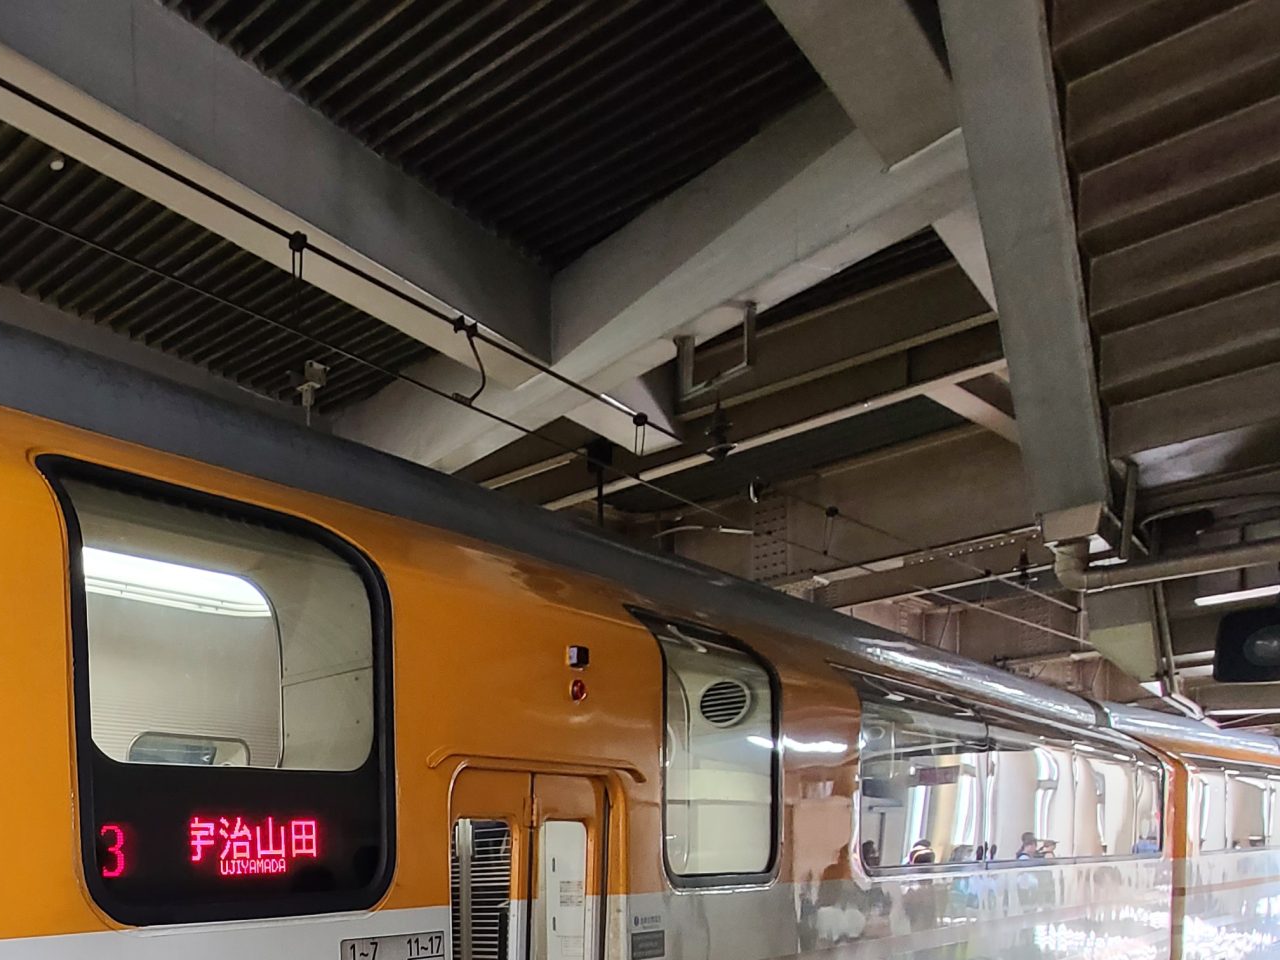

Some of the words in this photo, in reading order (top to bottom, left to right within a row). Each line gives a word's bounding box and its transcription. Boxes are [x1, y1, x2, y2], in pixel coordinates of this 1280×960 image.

[101, 825, 125, 877] 3
[190, 816, 317, 861] 宇治山田
[220, 859, 286, 875] UJIYAMADA
